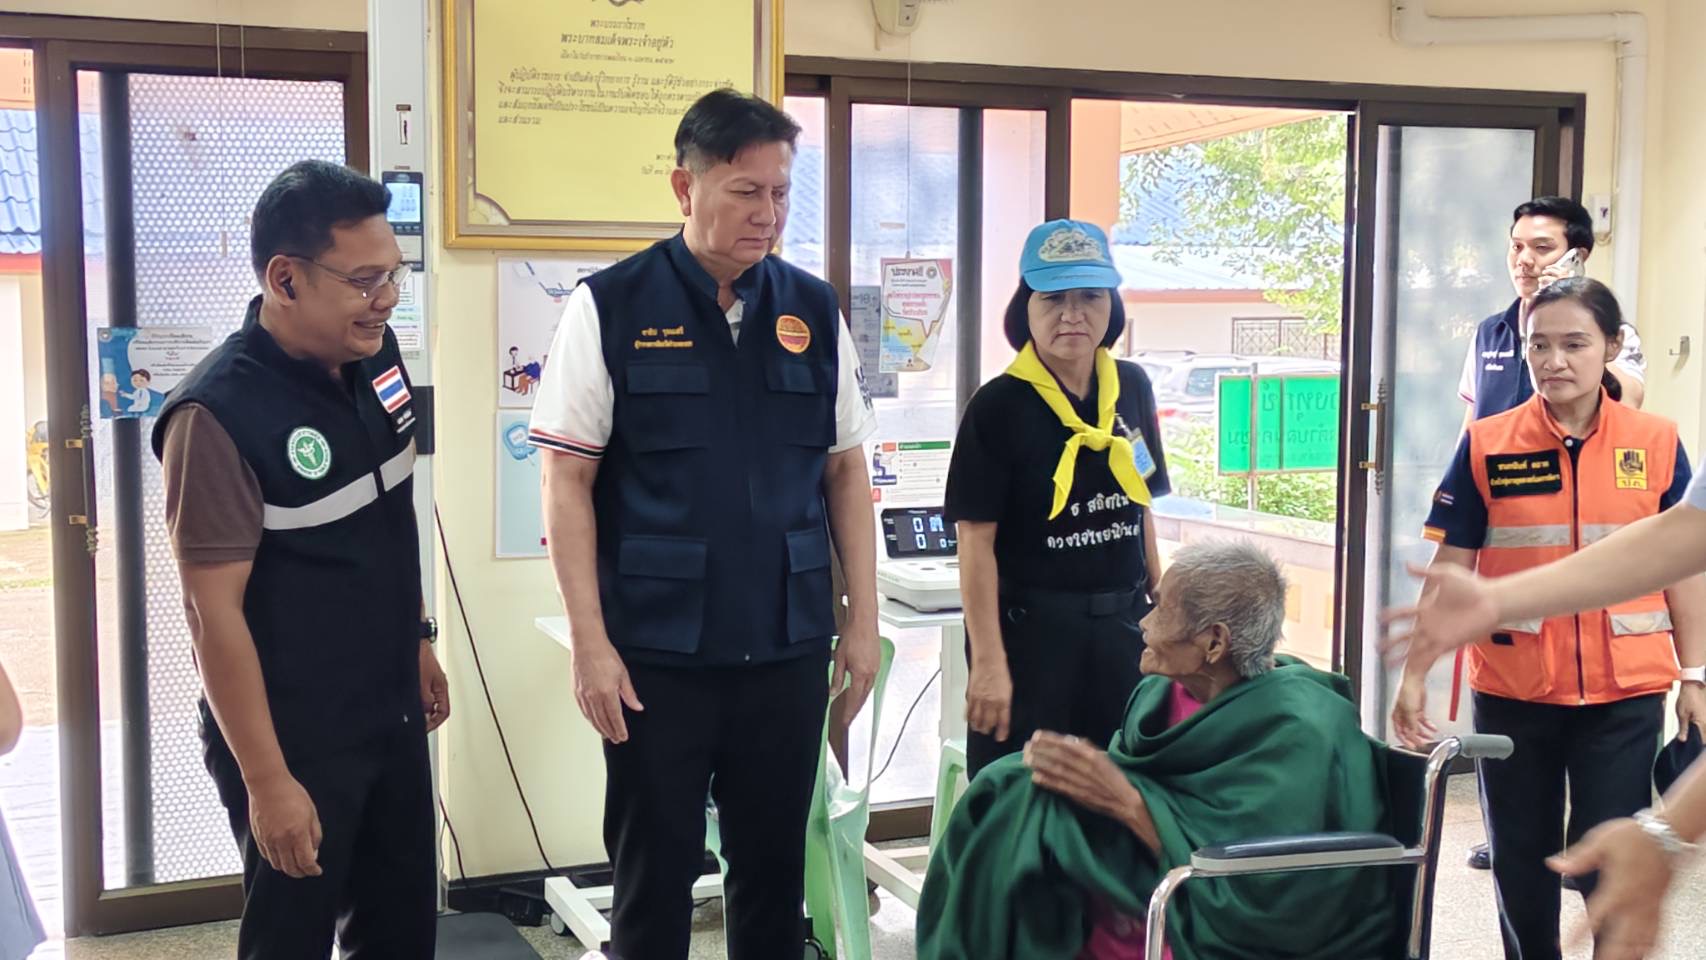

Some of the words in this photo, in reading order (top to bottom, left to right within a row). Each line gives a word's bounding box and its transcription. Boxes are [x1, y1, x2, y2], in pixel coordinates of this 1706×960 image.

[561, 33, 673, 52] พระบาทสมเด็จพระเจ้าอยู่หัว
[1070, 503, 1080, 516] ธ
